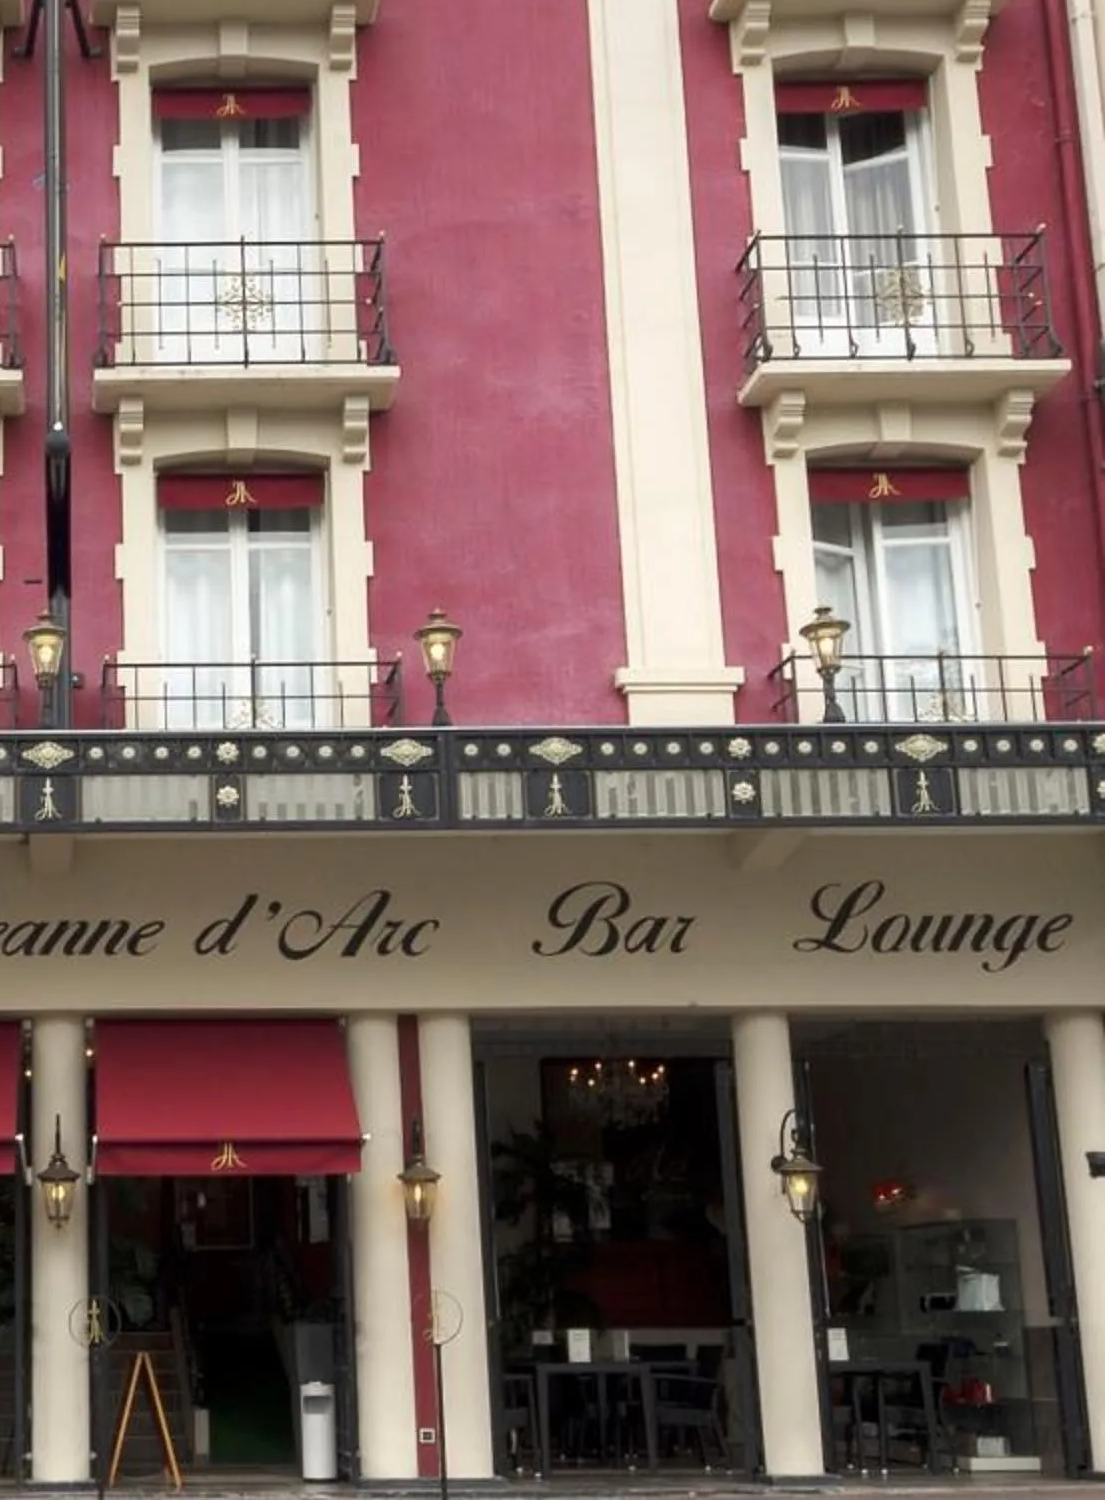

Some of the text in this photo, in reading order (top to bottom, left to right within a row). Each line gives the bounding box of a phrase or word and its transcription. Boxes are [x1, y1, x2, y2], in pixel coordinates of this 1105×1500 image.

[193, 888, 441, 961] d'Arc
[531, 879, 1075, 974] Bar Lounge
